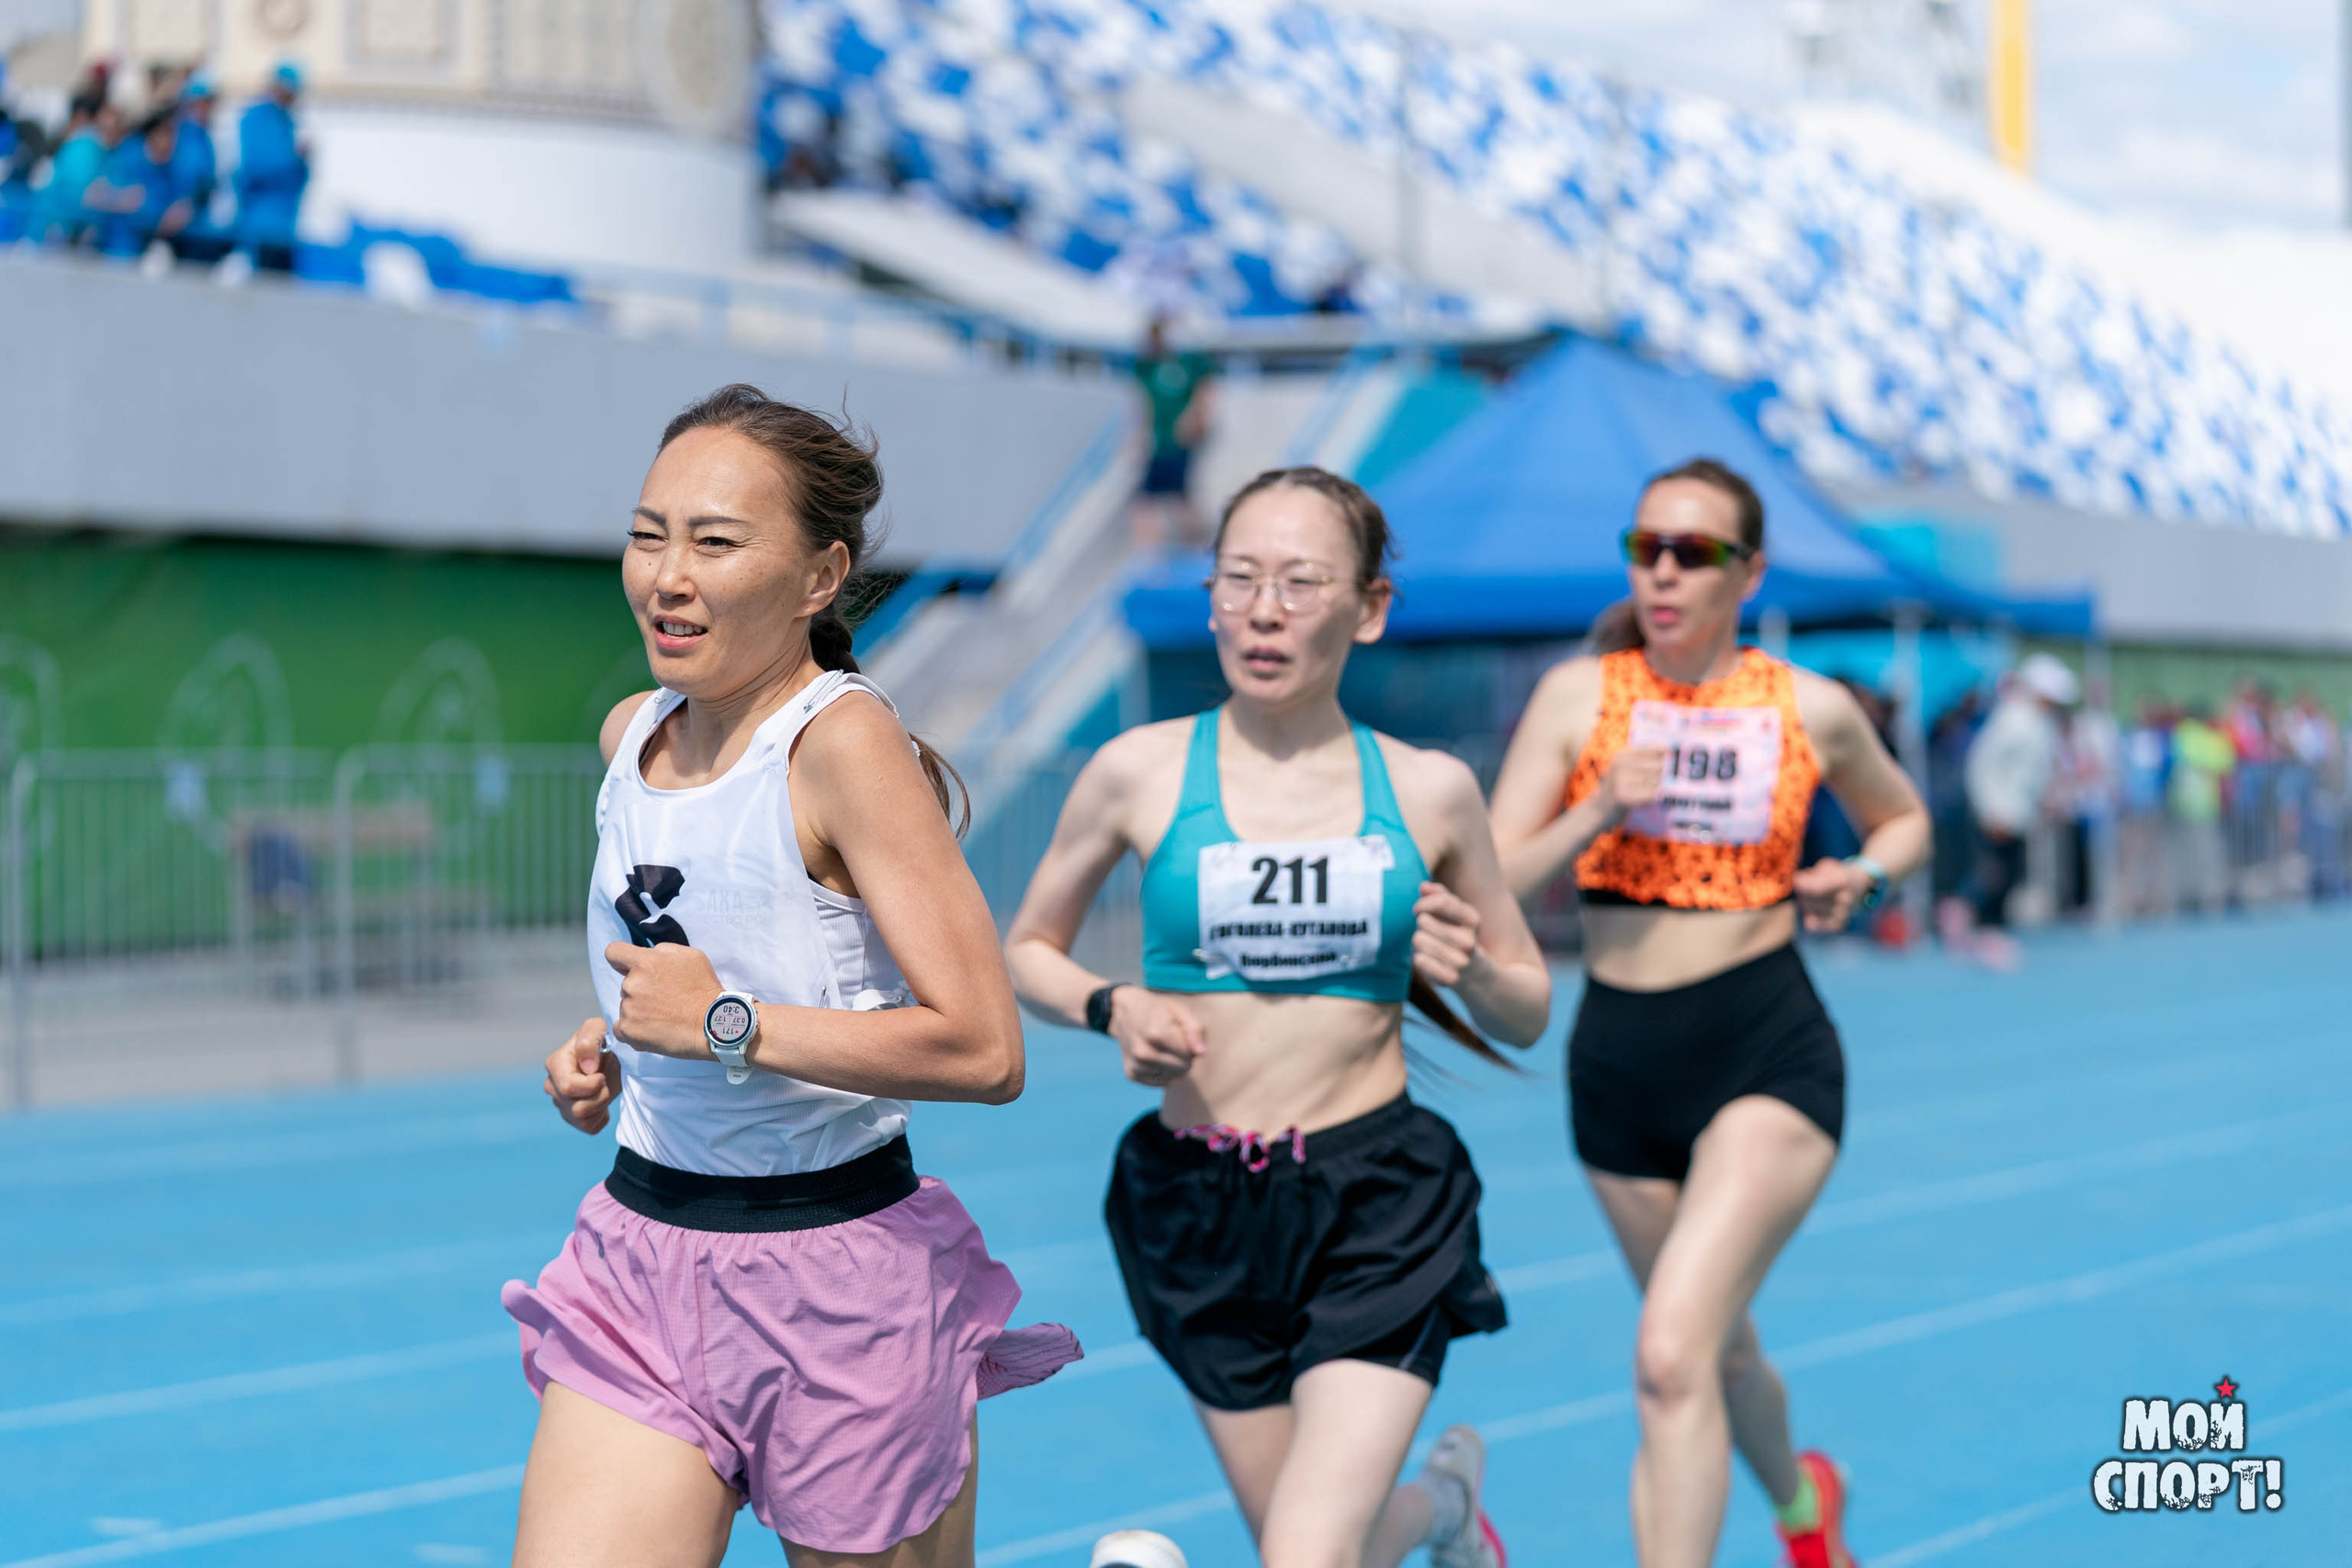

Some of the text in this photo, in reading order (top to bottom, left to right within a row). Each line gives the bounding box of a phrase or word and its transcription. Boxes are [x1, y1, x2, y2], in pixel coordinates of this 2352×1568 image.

[1670, 744, 1738, 781] 198
[1251, 854, 1329, 905] 211
[723, 1005, 740, 1014] 3:40
